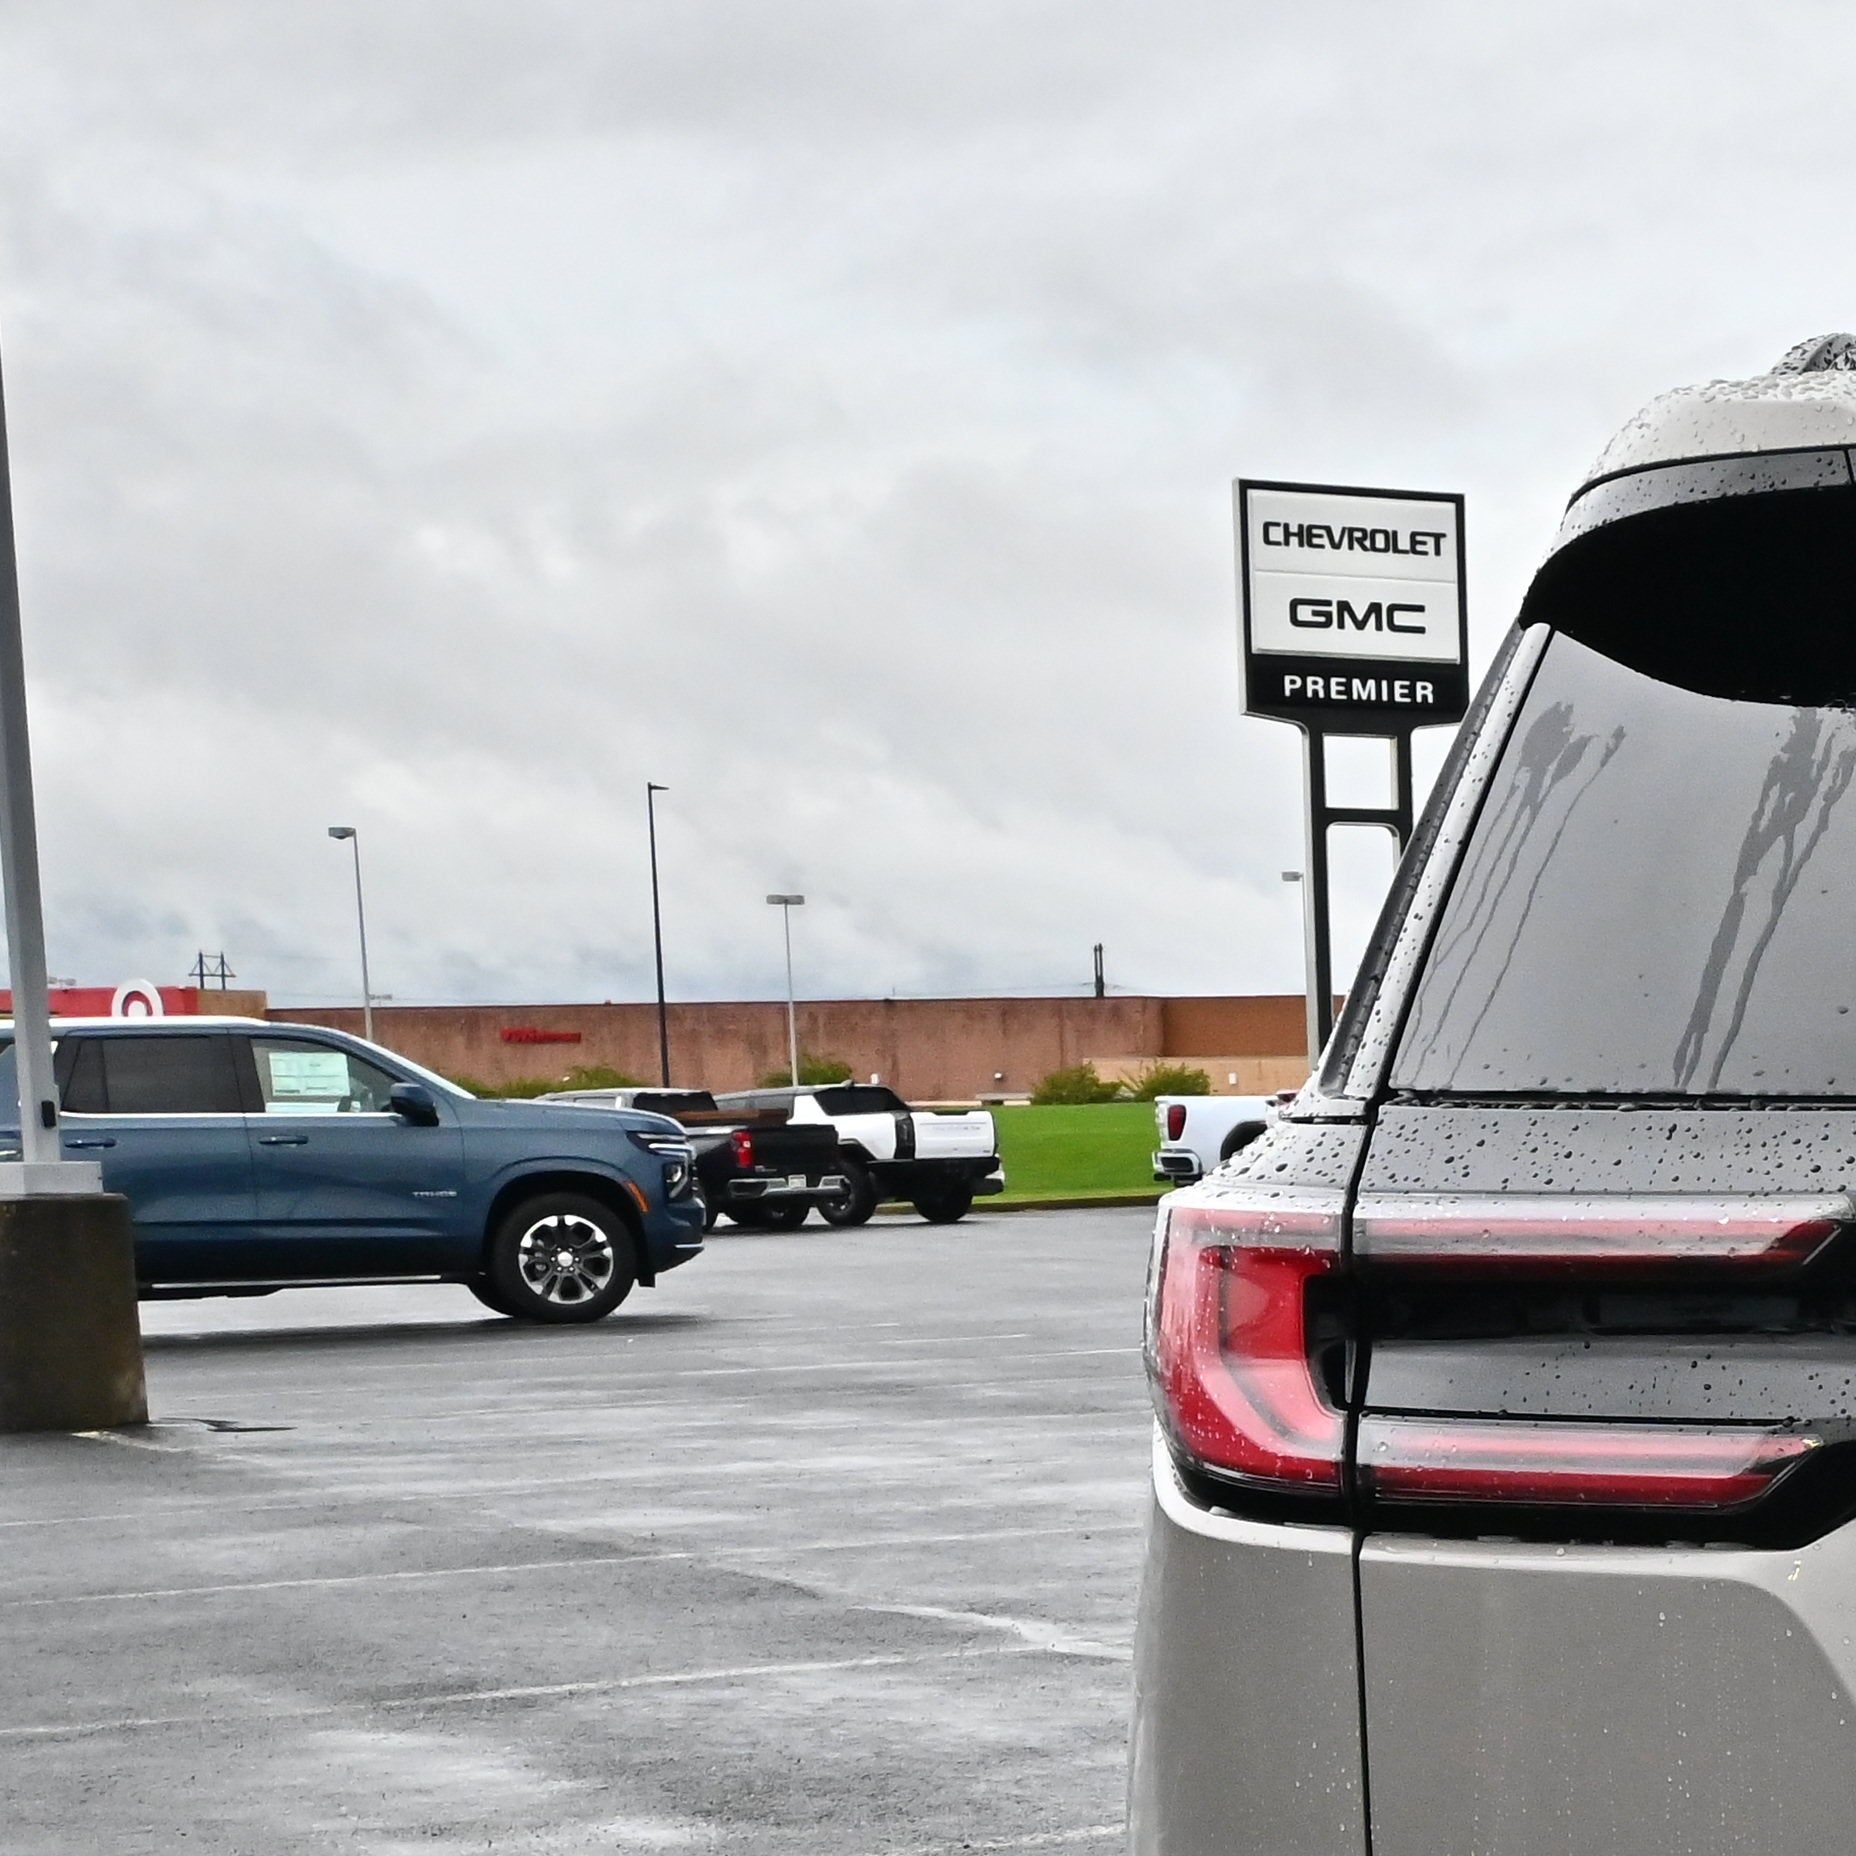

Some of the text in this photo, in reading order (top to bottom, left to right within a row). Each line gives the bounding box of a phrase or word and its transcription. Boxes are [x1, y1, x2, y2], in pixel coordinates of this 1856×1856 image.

[1262, 520, 1447, 557] CHEVROLET
[1288, 597, 1426, 635] GMC
[1283, 674, 1435, 704] PREMIER
